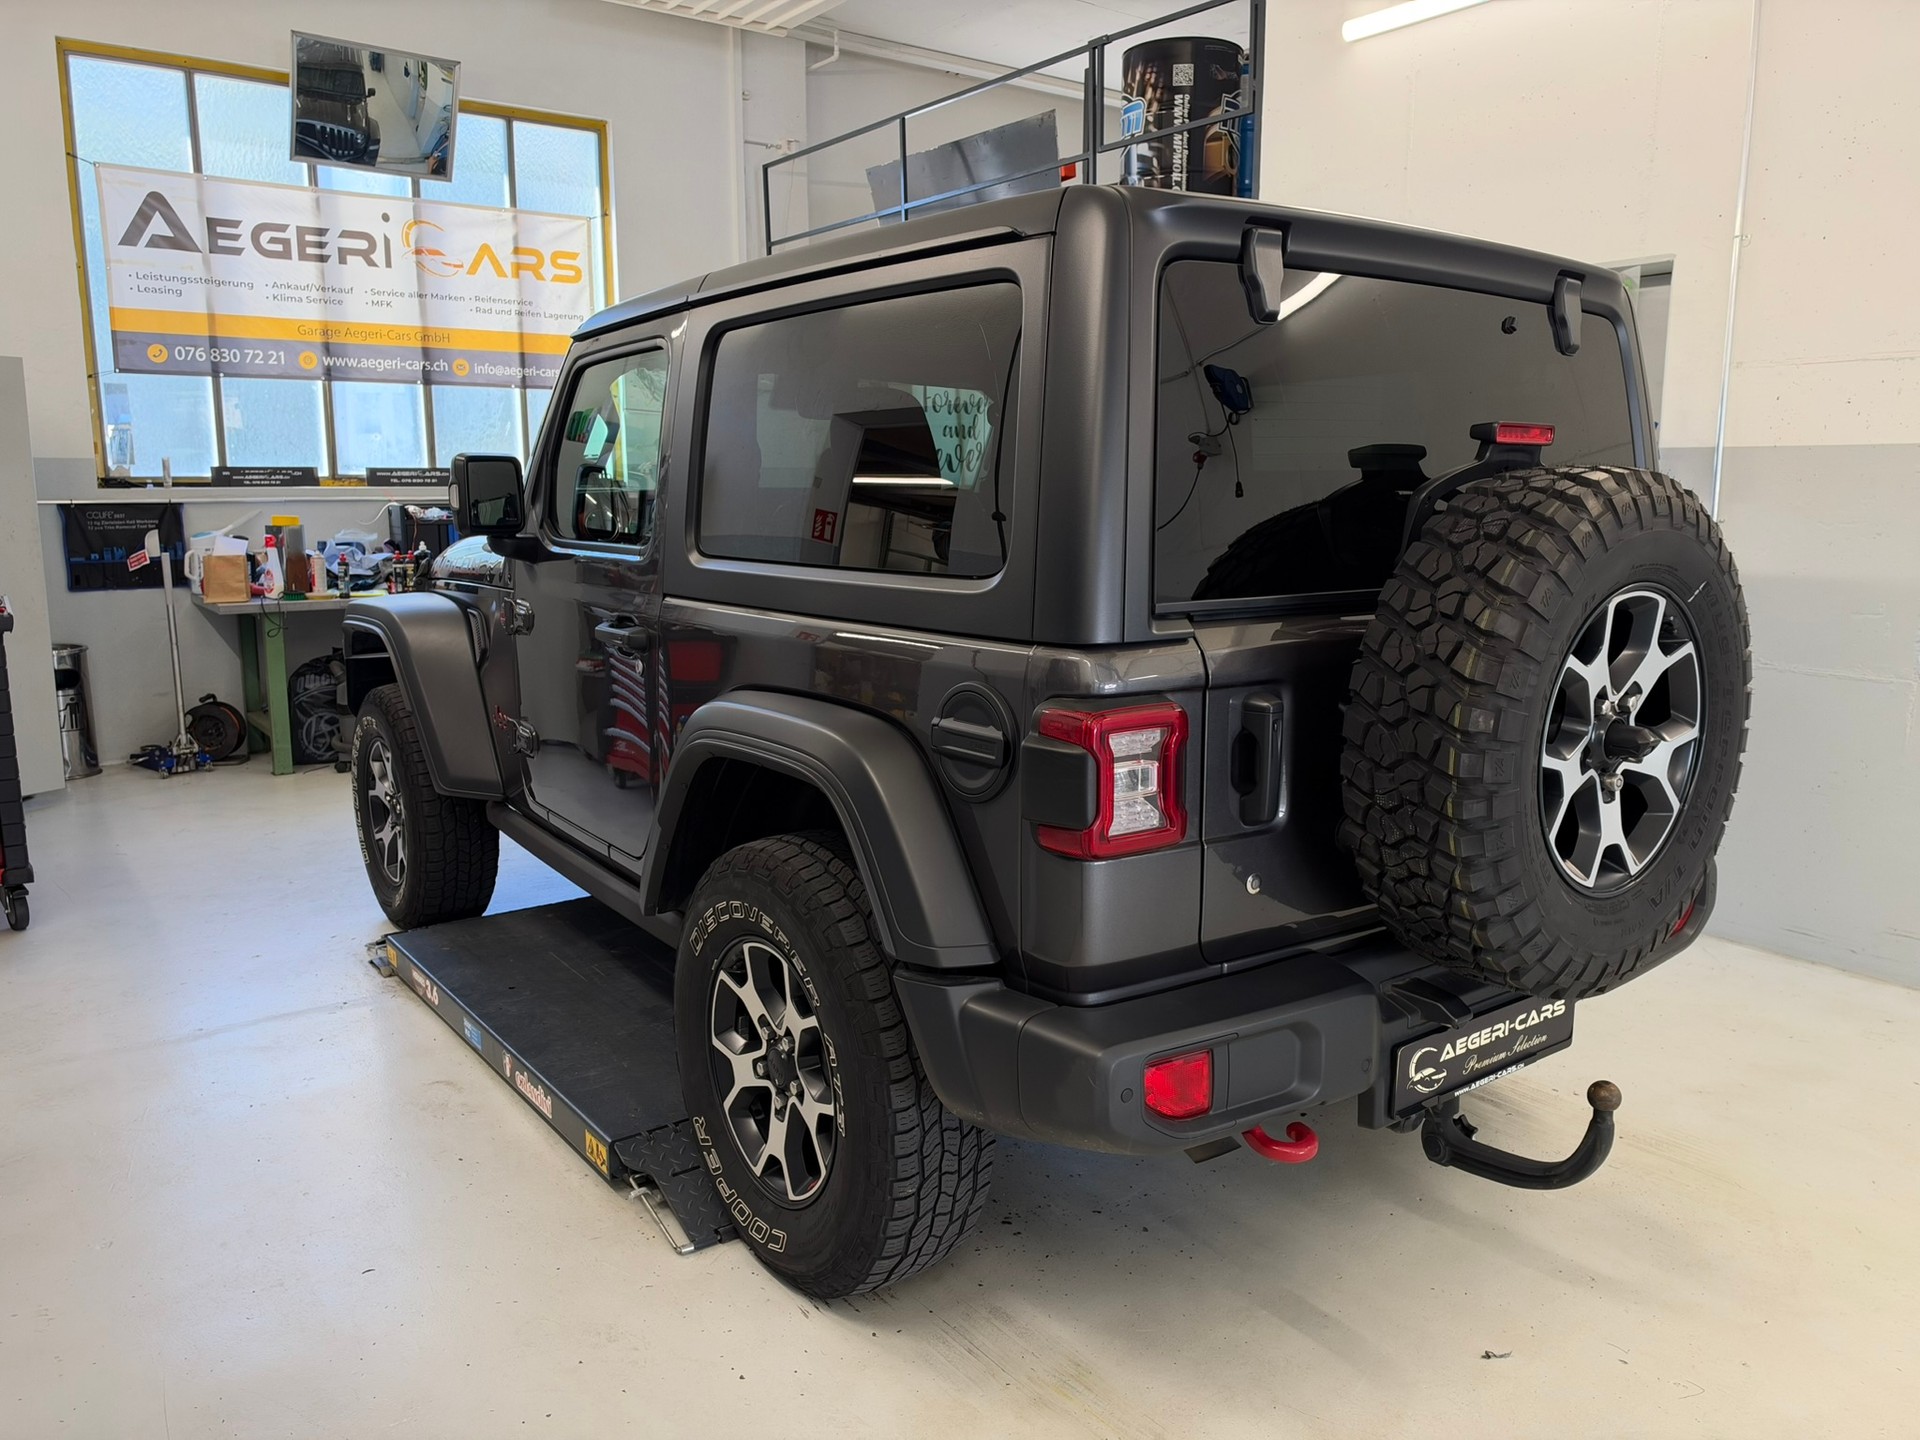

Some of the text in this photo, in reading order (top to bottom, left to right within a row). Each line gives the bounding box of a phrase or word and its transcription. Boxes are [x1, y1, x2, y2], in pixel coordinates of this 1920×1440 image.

[135, 271, 255, 290] Leistungssteigerung
[271, 281, 355, 295] Ankauf/Verkauf
[137, 284, 183, 297] Leasing
[370, 288, 466, 303] Service aller Marken
[272, 294, 344, 306] Klima Service
[371, 300, 393, 309] MFK
[474, 295, 534, 307] Reifenservice
[475, 307, 584, 322] Rad und Reifen Lagerung
[297, 324, 450, 344] Garage Aegeri-Cars GmbH
[174, 346, 207, 362] 076
[210, 347, 241, 363] 830
[322, 356, 449, 373] www.aegeri-cars.ch
[942, 414, 978, 440] and
[688, 899, 822, 1008] DISCOVERER
[1439, 999, 1567, 1063] AEGERI-CARS
[1462, 1033, 1548, 1076] Premium Selection
[691, 1115, 789, 1254] COOPER
